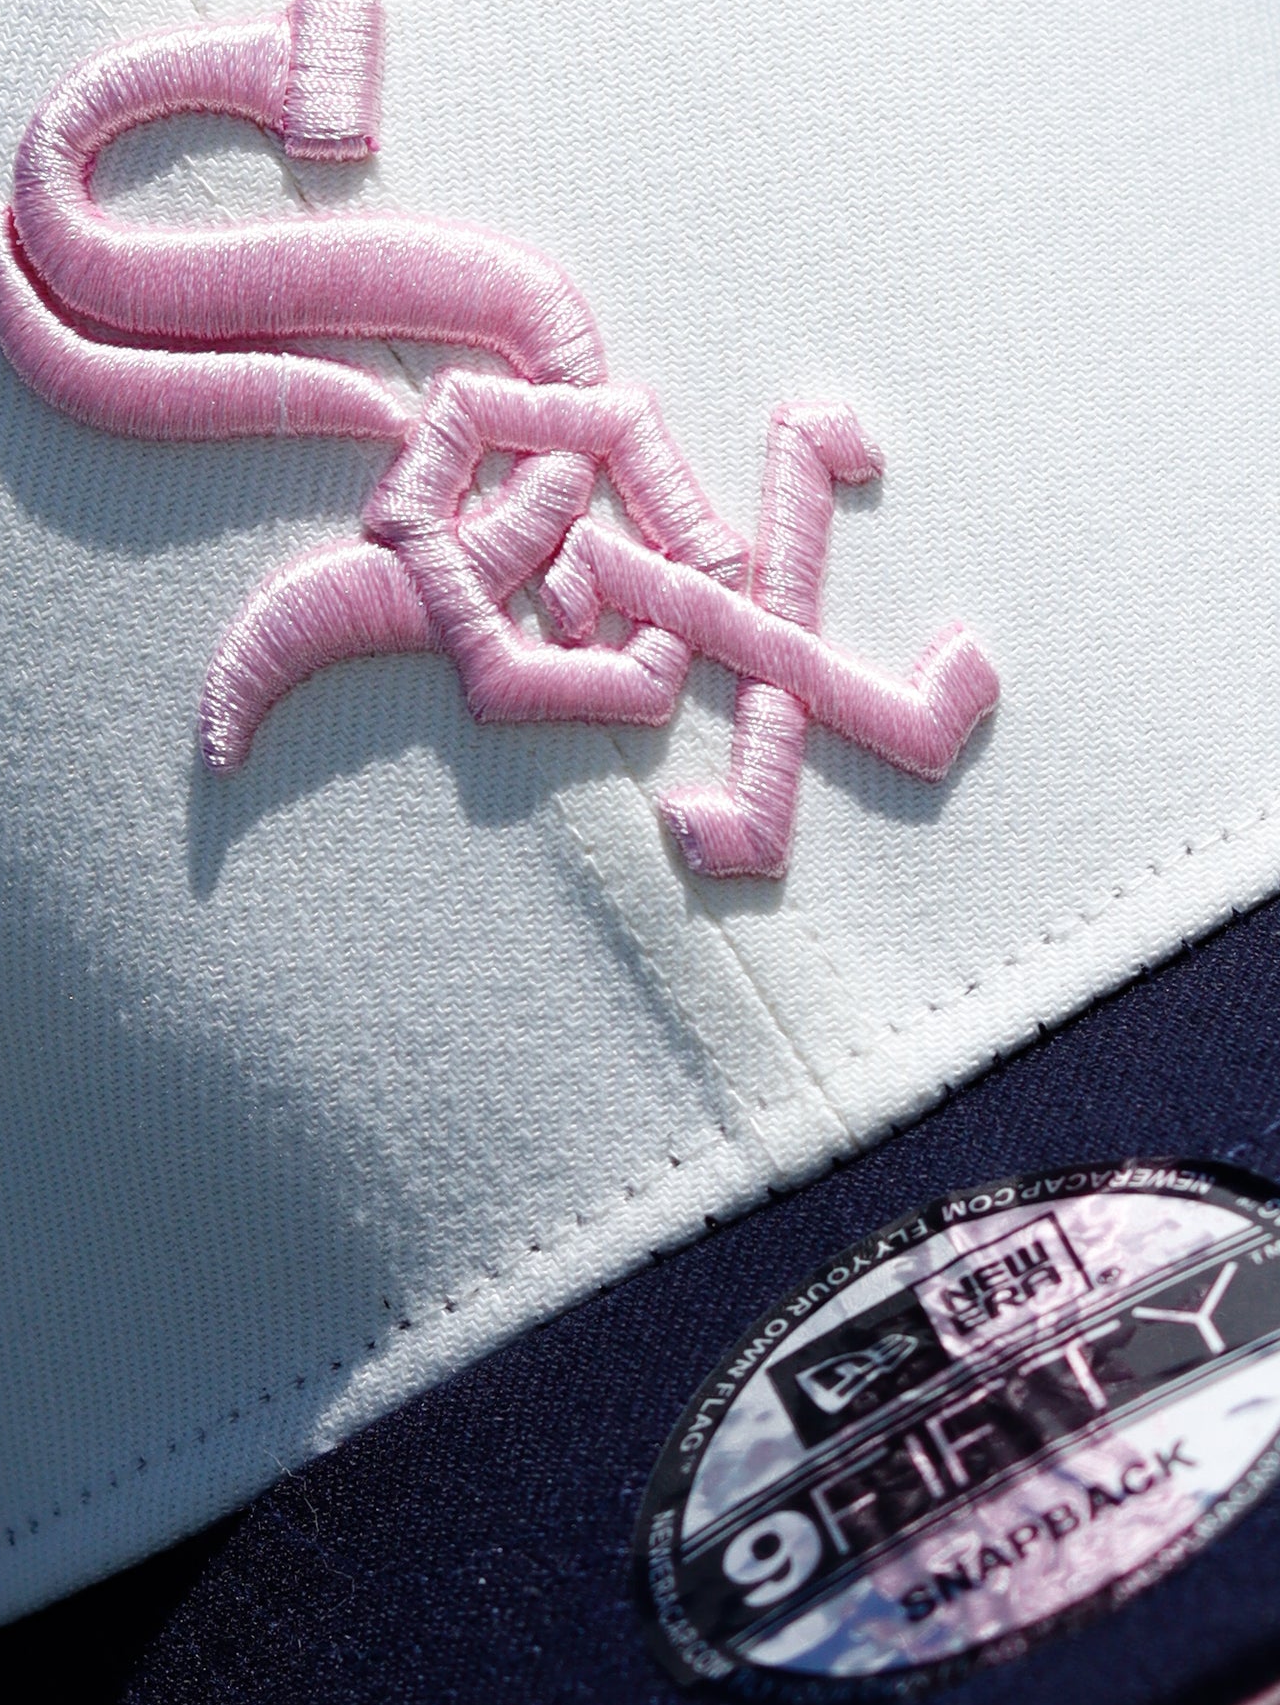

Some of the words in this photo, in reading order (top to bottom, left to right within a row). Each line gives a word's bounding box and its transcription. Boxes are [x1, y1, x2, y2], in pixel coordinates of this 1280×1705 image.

[941, 1167, 1216, 1222] NEWERACAP.COM
[871, 1217, 929, 1259] FLY
[785, 1253, 871, 1317] YOUR
[940, 1240, 1050, 1312] NEW
[951, 1265, 1062, 1336] ERA
[725, 1320, 789, 1381] OWN
[721, 1261, 1238, 1608] 9FIFTY
[899, 1438, 1199, 1624] SNAPBACK
